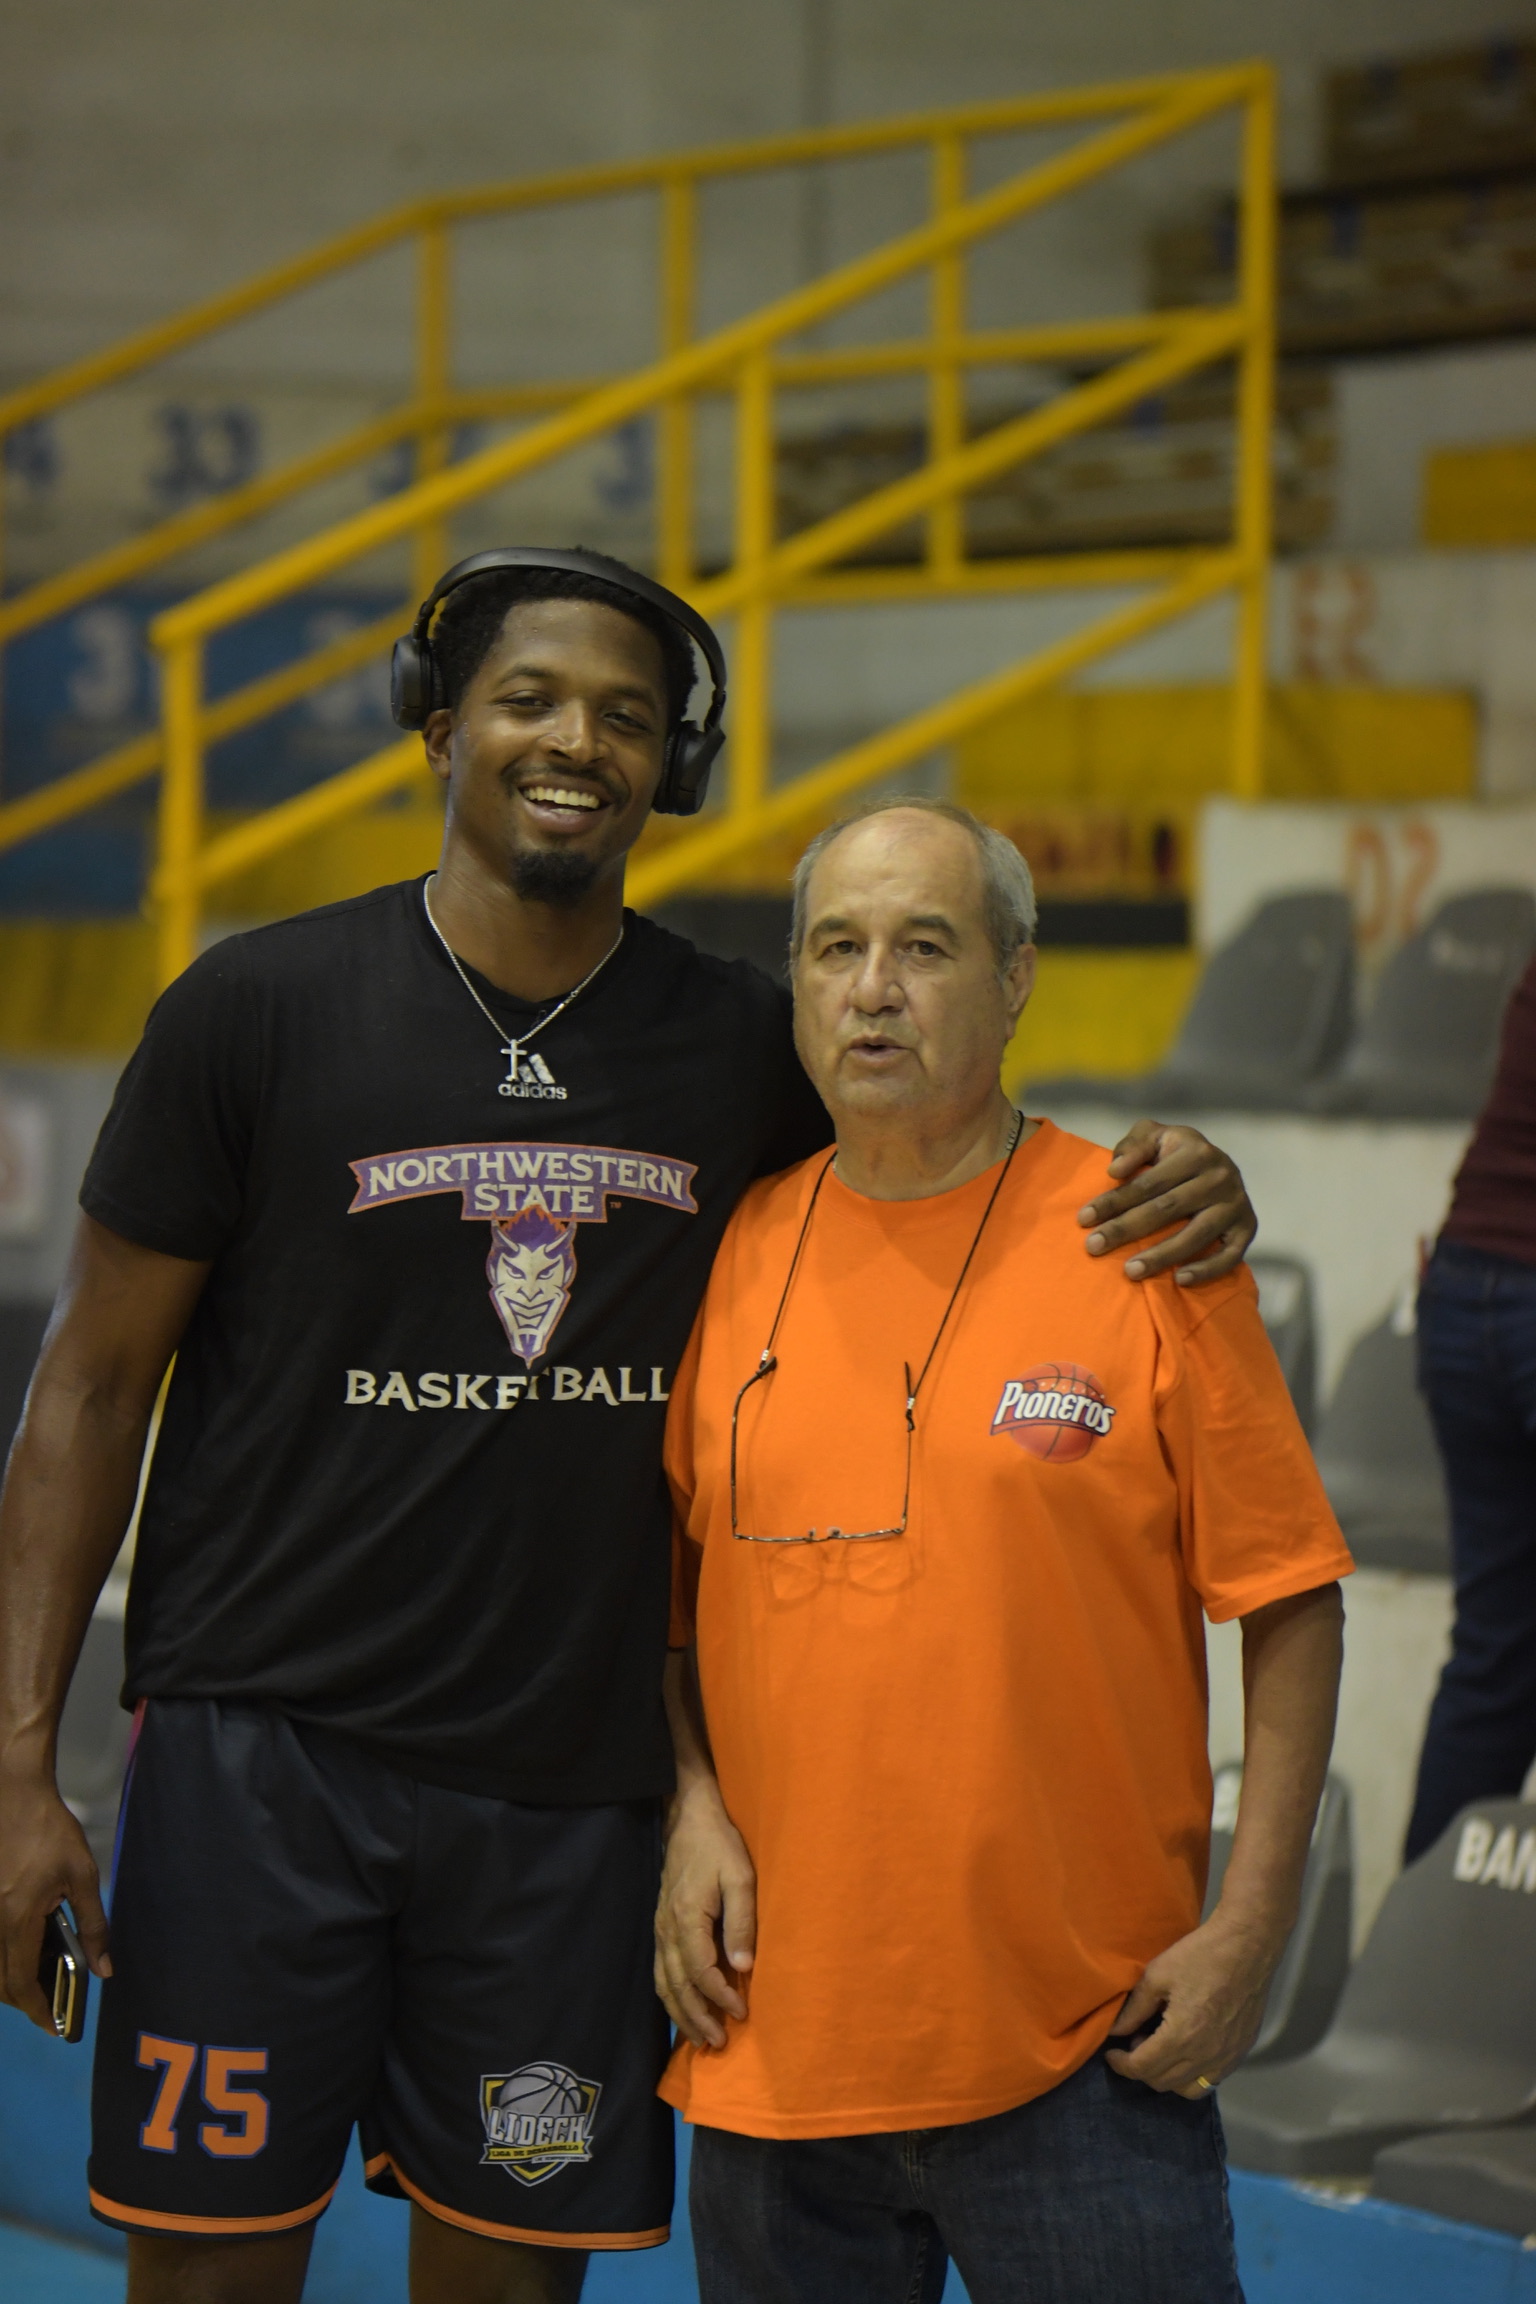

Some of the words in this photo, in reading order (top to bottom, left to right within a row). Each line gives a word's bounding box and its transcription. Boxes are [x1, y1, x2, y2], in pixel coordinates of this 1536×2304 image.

[498, 1082, 568, 1100] adidas
[368, 1151, 683, 1201] NORTHWESTERN
[474, 1183, 594, 1213] STATE
[135, 2030, 271, 2159] 75
[489, 2107, 586, 2146] LIDECH
